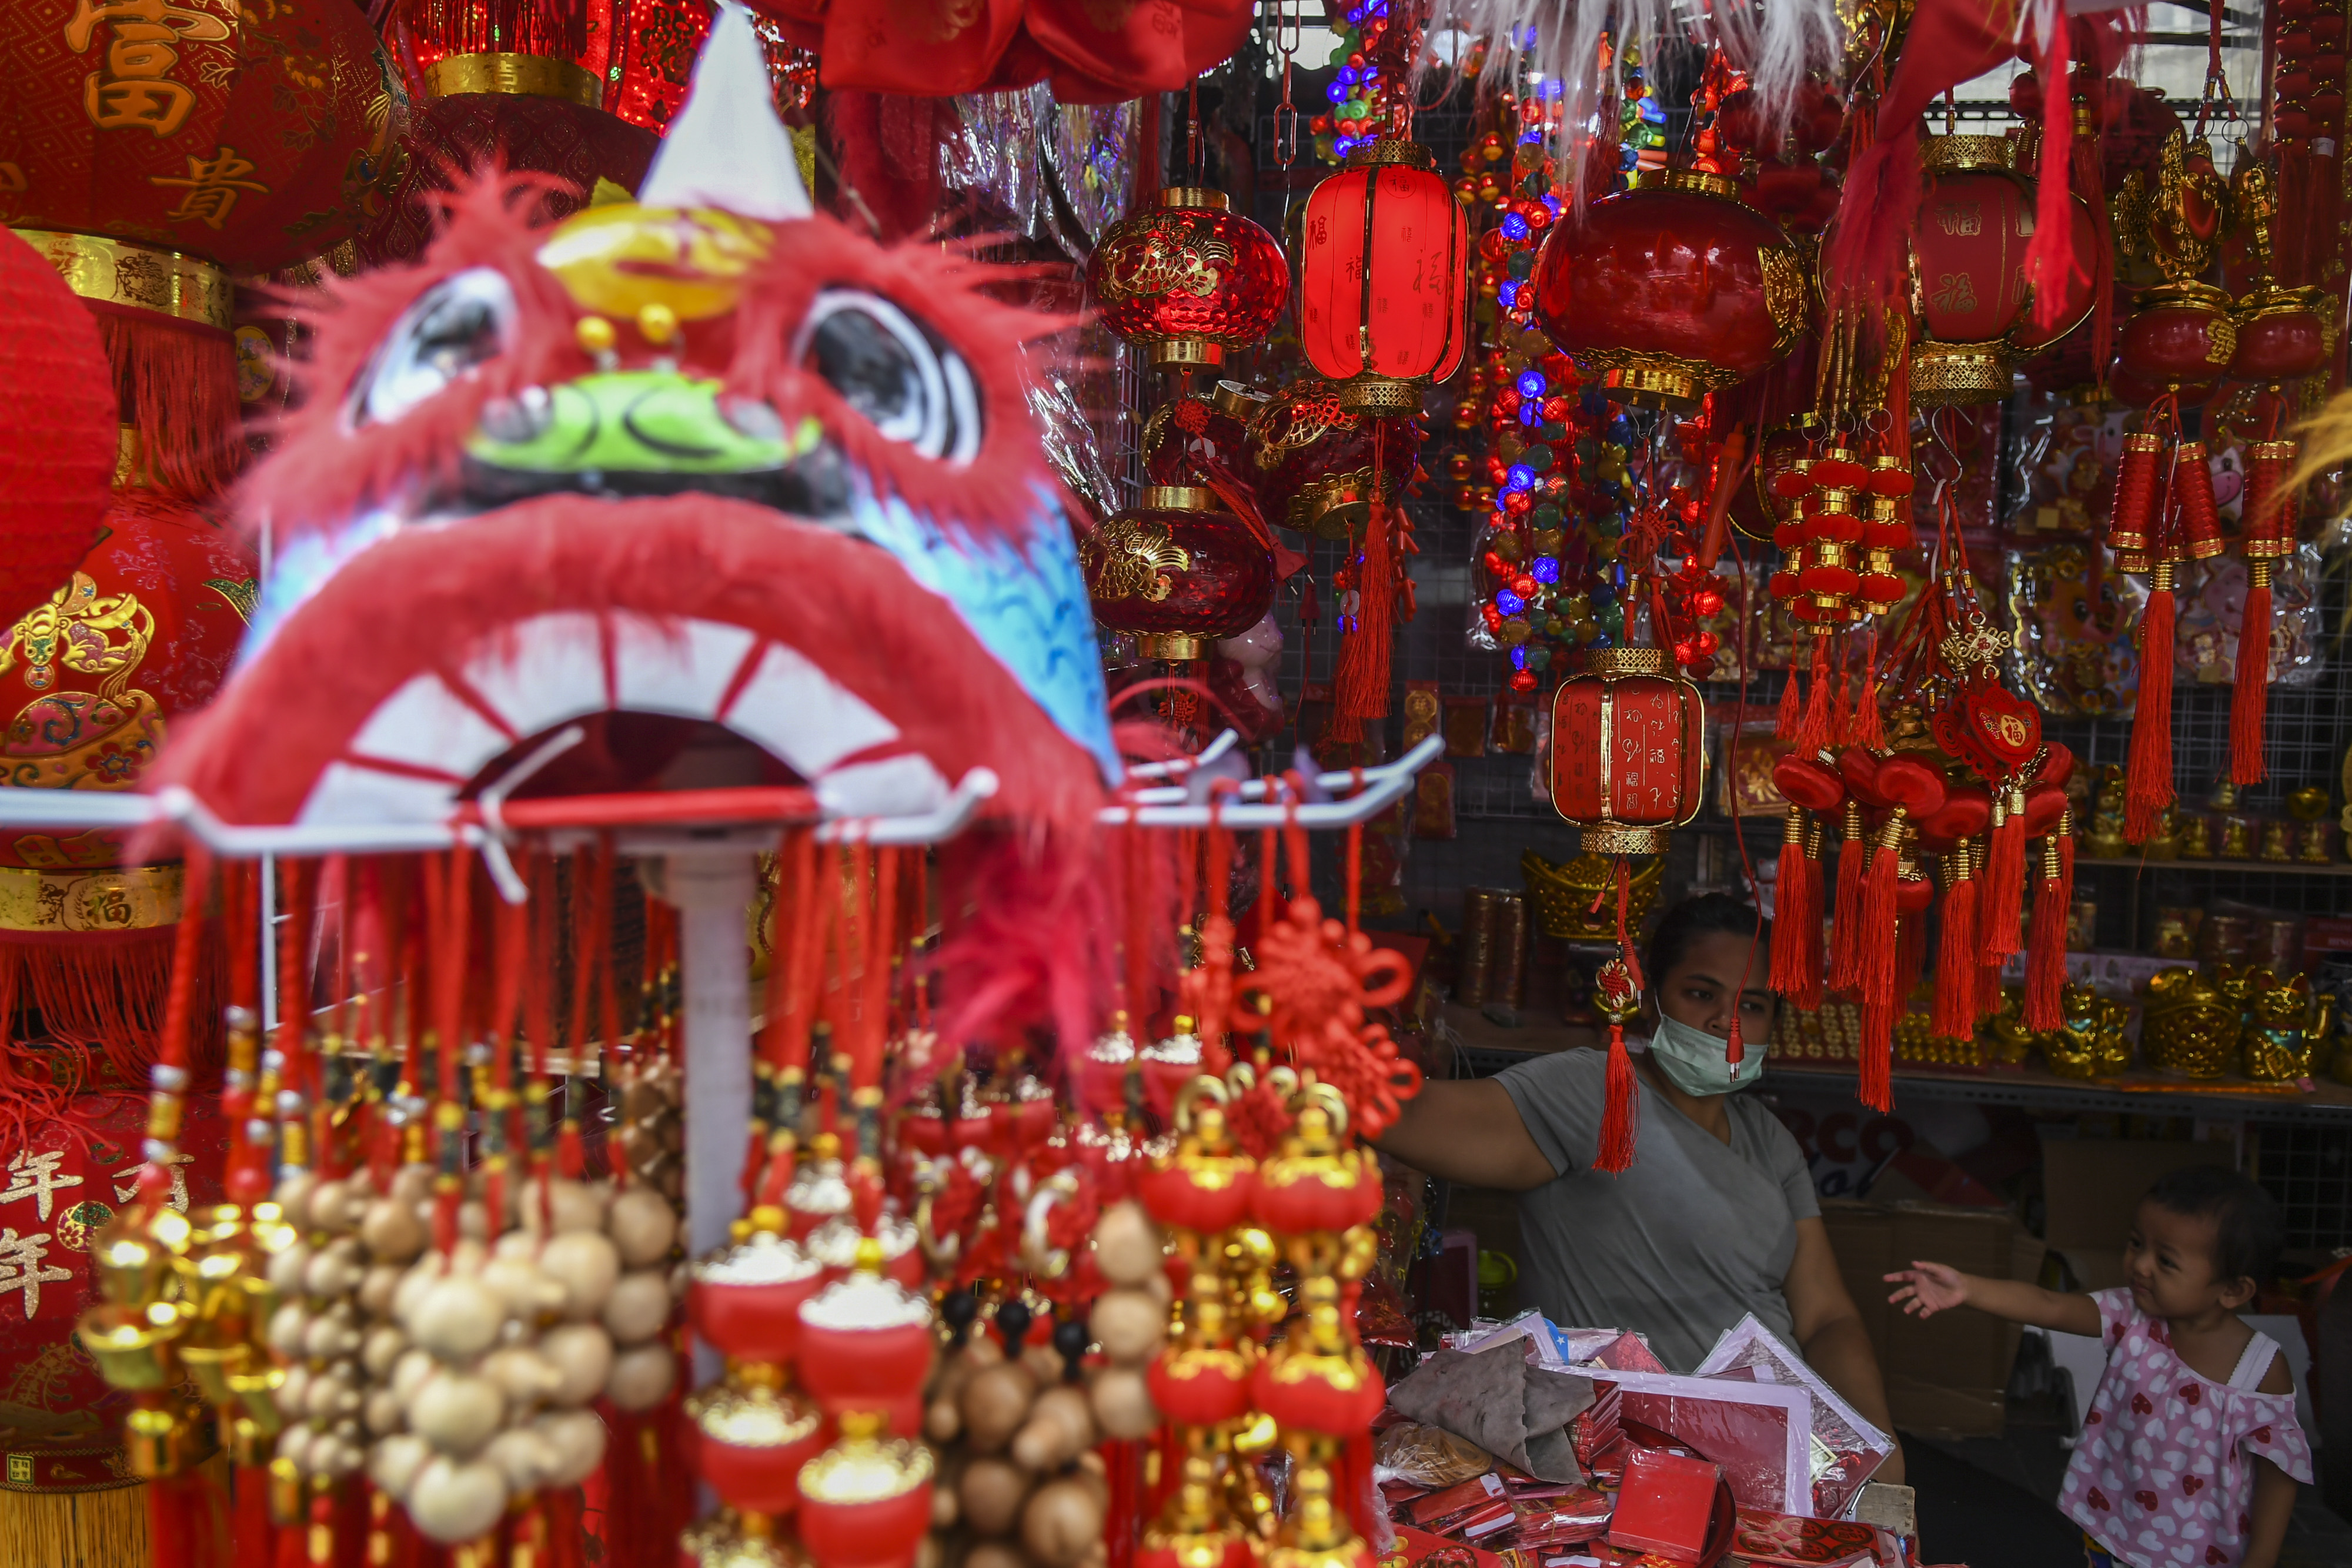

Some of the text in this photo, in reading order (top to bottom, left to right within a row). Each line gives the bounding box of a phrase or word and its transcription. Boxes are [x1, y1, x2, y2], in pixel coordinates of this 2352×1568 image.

[64, 0, 231, 139] 富
[151, 146, 270, 230] 貴
[1389, 175, 1409, 192] 福
[1936, 200, 1982, 236] 福
[2000, 716, 2024, 744] 福
[82, 887, 132, 924] 福
